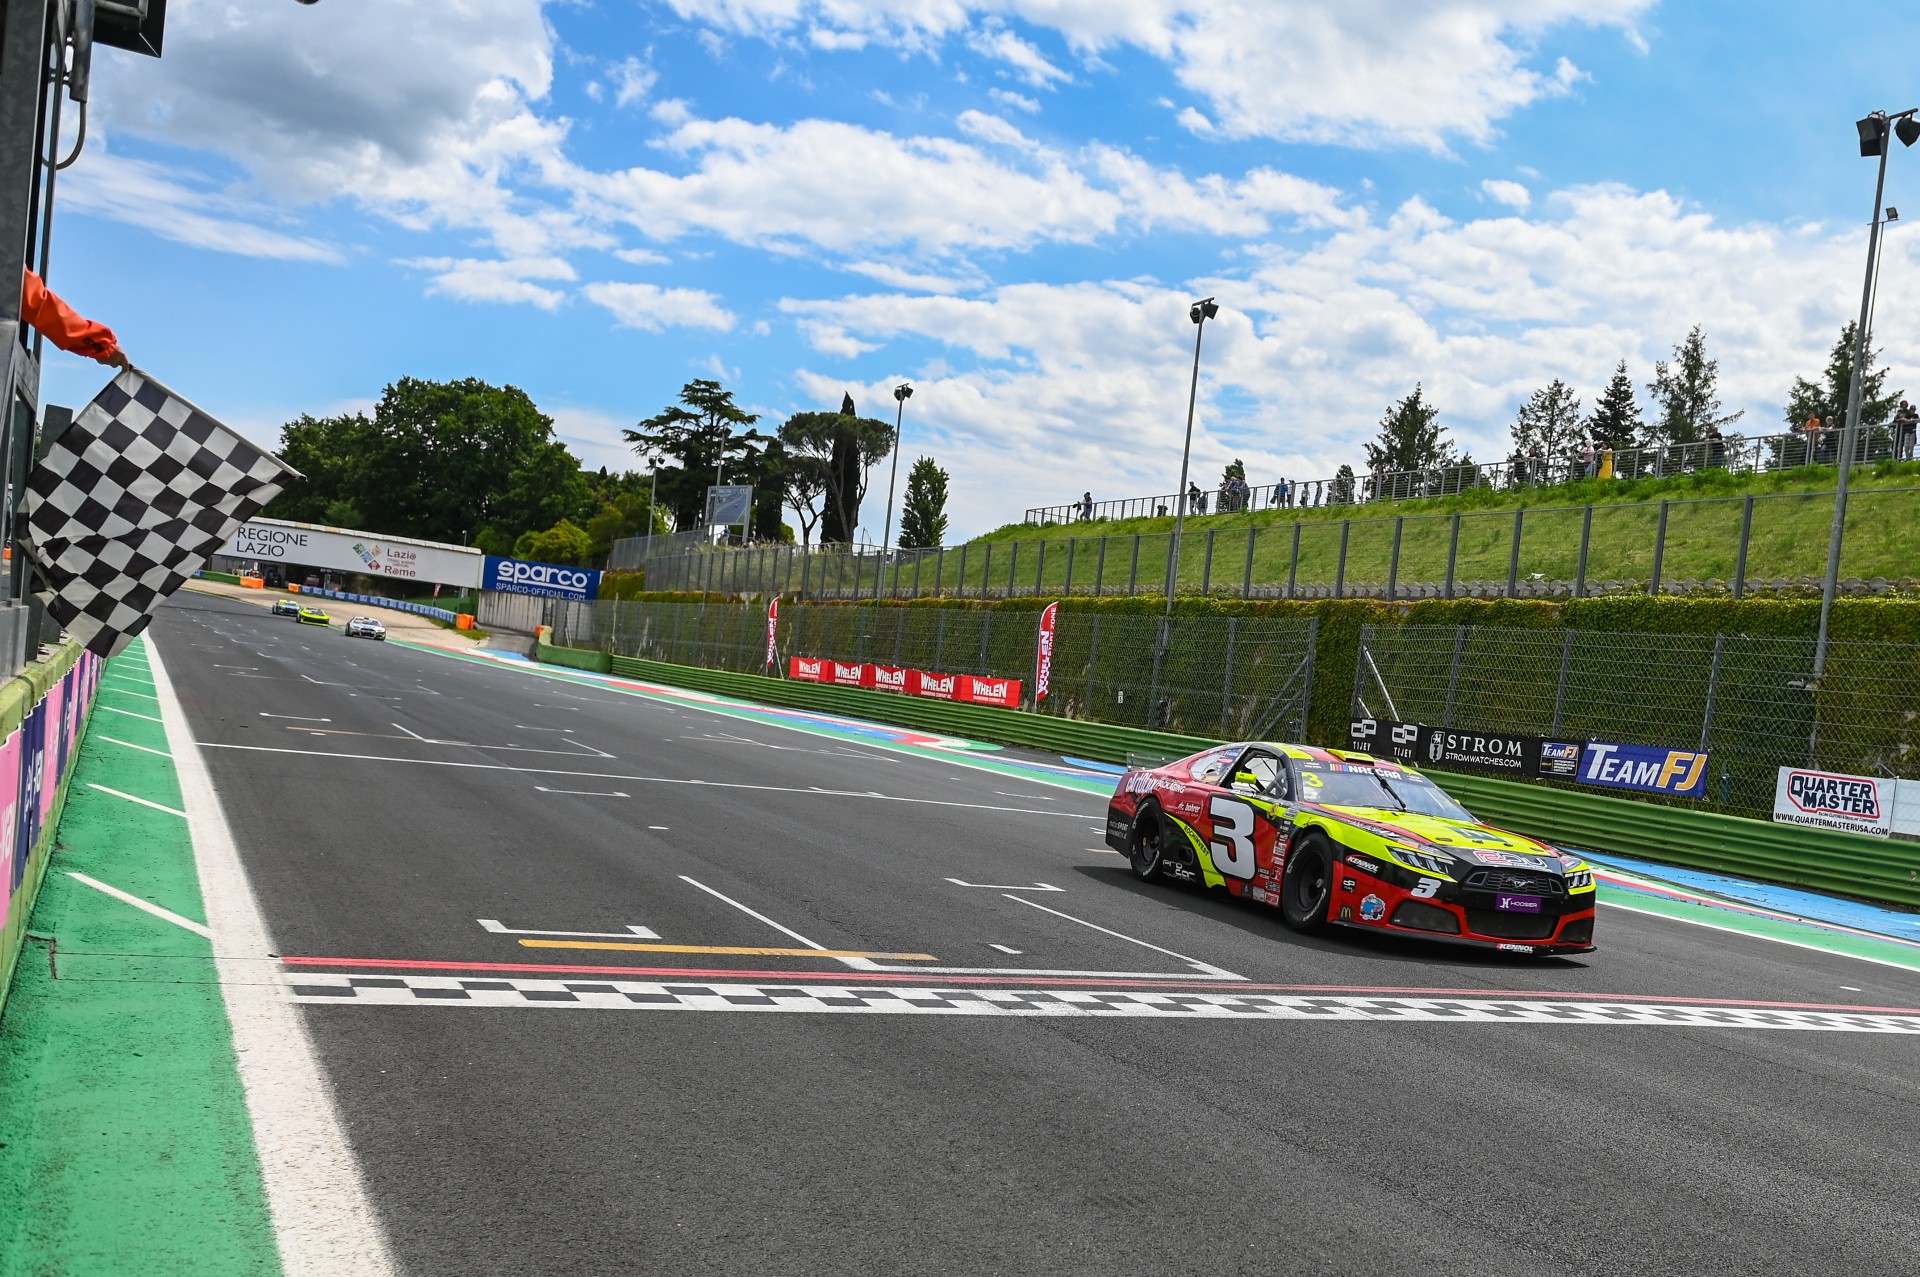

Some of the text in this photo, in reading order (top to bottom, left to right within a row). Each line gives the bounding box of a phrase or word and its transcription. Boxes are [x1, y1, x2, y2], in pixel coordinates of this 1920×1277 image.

[237, 526, 308, 547] REGIONE
[236, 540, 285, 557] LAZIO
[497, 561, 588, 588] sparco
[799, 660, 821, 675] WHELEN
[835, 662, 862, 680] WHELEN
[876, 666, 906, 686] WHELEN
[921, 673, 955, 693] WHELEN
[973, 679, 1008, 698] WHELEN
[1446, 734, 1523, 757] STROM
[1445, 752, 1522, 769] STROMWATCHES.COM
[1301, 771, 1323, 788] 3
[1347, 765, 1402, 780] NASCAR
[1790, 776, 1872, 799] QUARTER
[1802, 792, 1875, 815] MASTER
[1775, 812, 1888, 836] WWW.QUARTERMASTERUSA.COM
[1210, 796, 1255, 880] 3
[1348, 856, 1380, 873] KENNOL
[1410, 877, 1442, 898] 3
[1500, 943, 1534, 952] KENNOL
